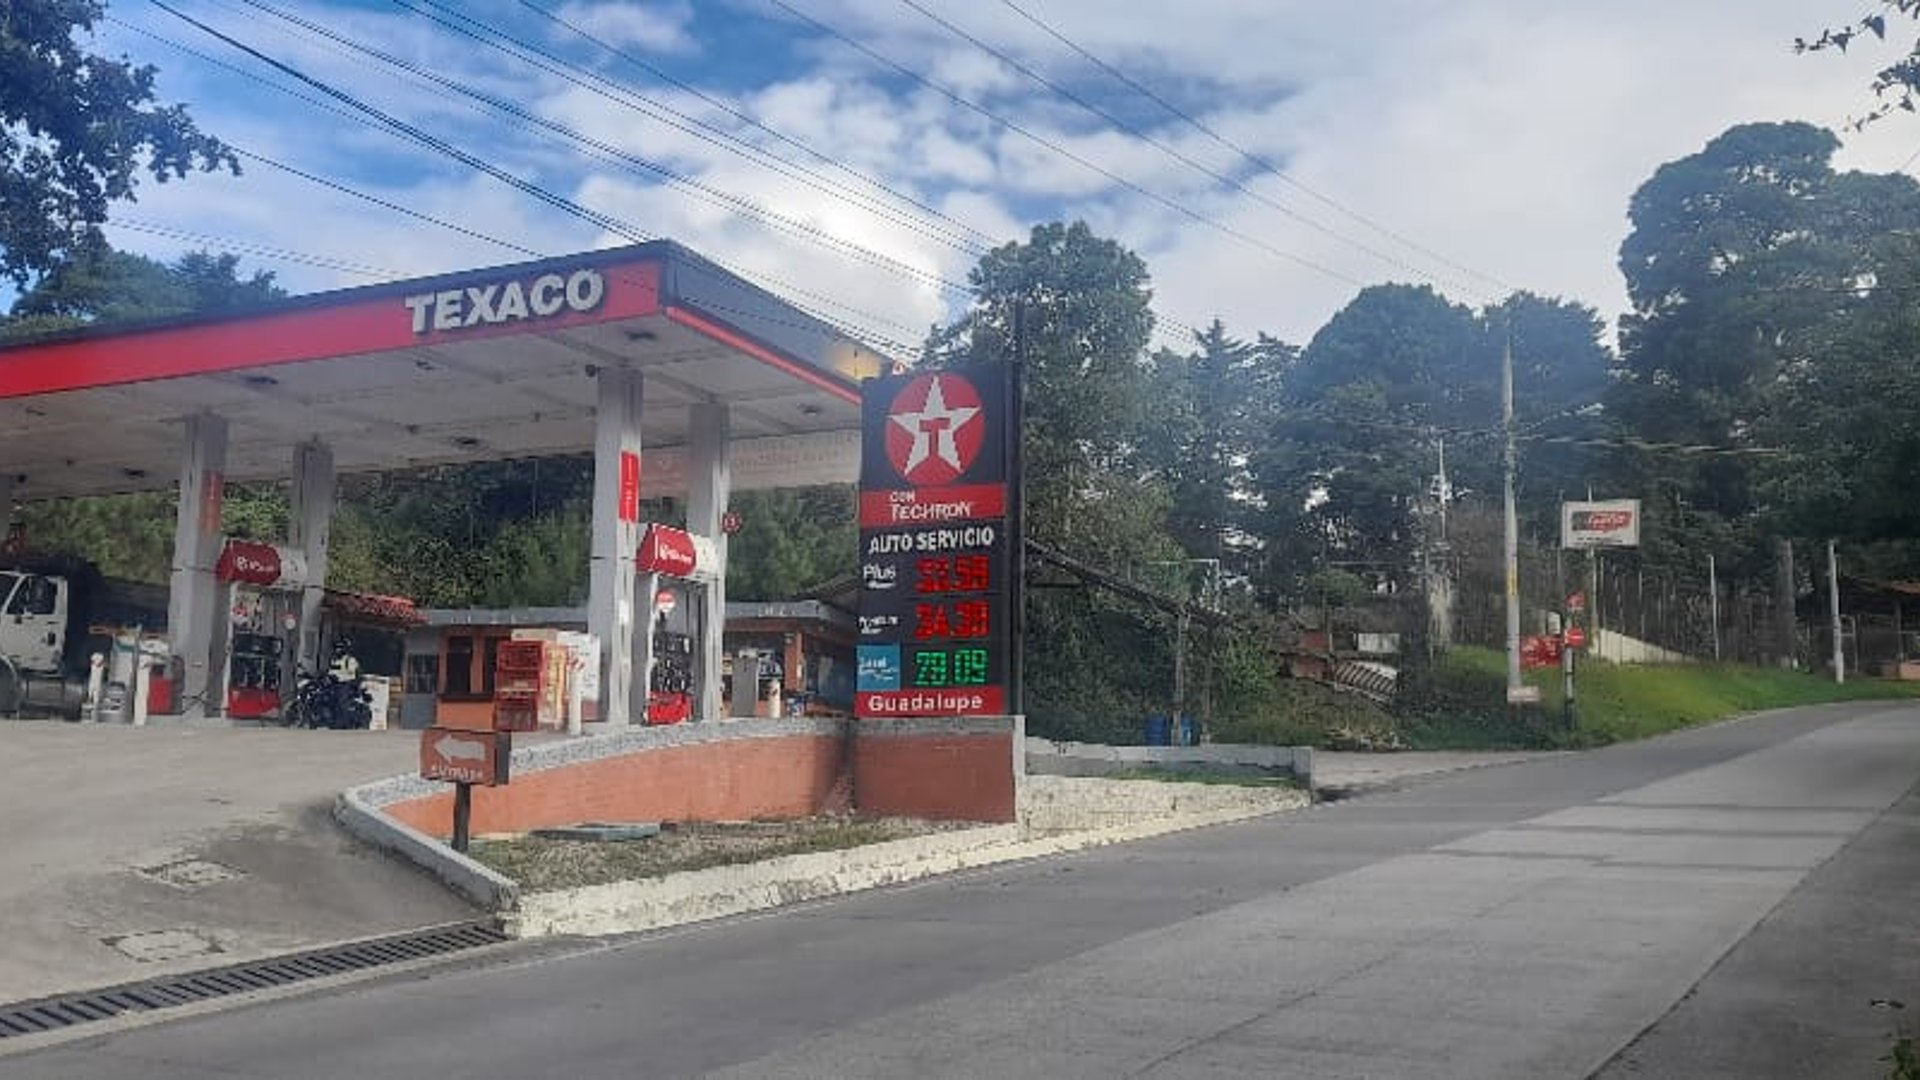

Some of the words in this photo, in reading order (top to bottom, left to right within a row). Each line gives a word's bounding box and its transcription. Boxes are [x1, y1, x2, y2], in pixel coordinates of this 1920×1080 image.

[405, 269, 604, 333] TEXACO
[891, 501, 972, 521] TECHRON
[868, 534, 913, 554] AUTO
[916, 526, 994, 551] SERVICIO
[863, 563, 896, 580] Plus
[868, 693, 983, 712] Guadalupe
